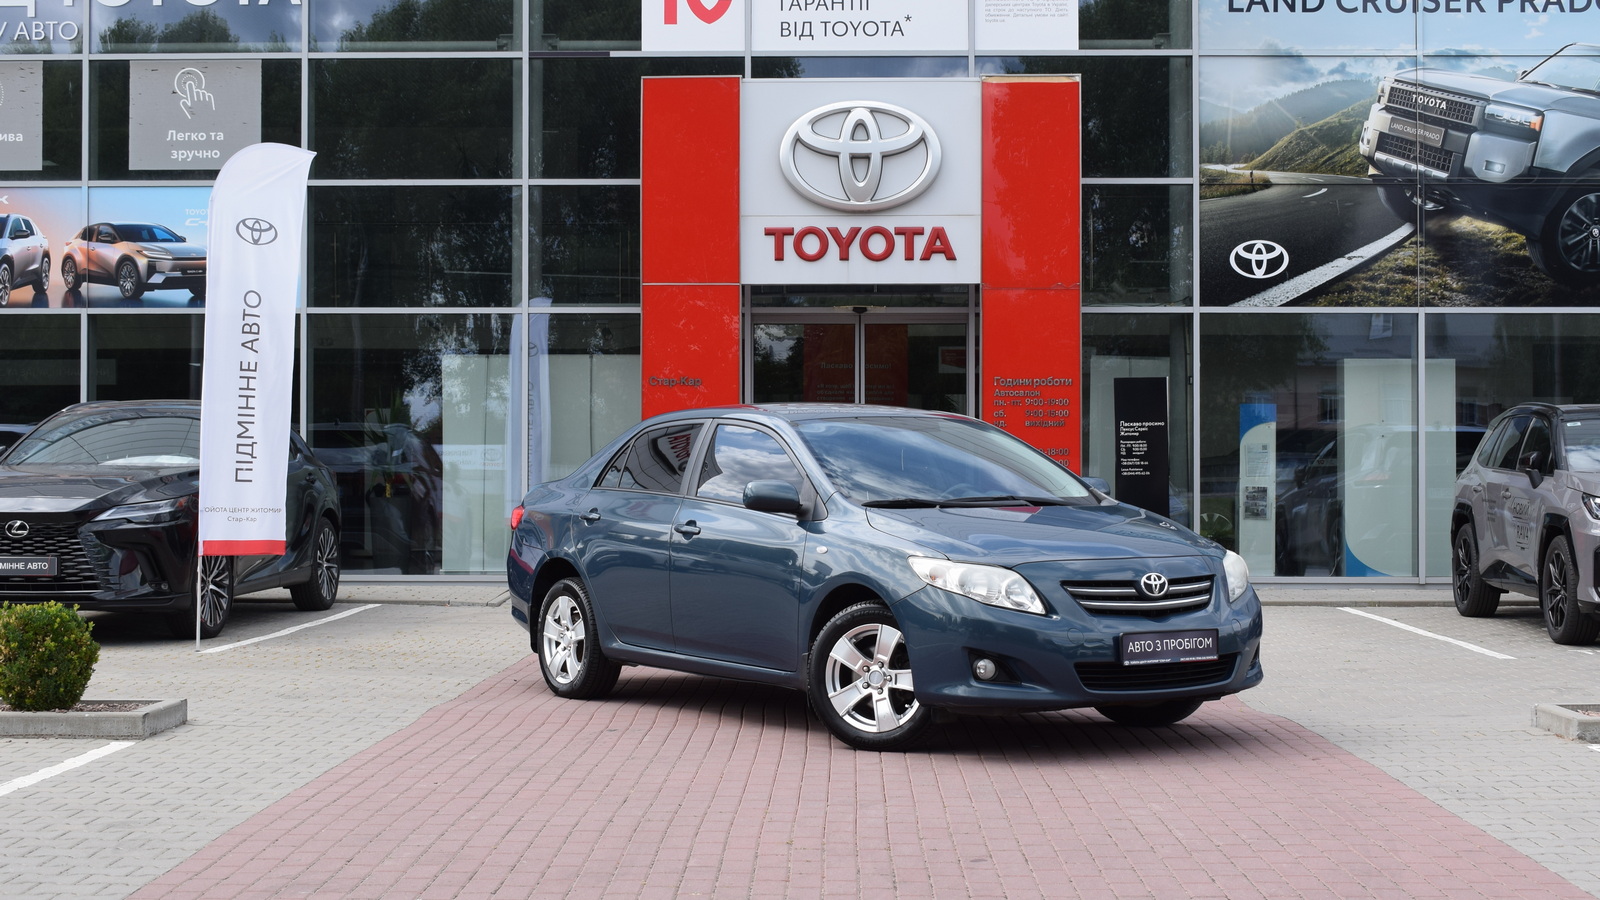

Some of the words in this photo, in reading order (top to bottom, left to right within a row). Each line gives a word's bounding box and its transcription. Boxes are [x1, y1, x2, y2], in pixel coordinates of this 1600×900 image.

[14, 21, 78, 40] АВТО
[780, 22, 814, 40] ВІД
[1412, 94, 1446, 110] TOYOTA
[166, 130, 206, 142] Легко
[210, 132, 224, 141] та
[1390, 122, 1403, 130] LAND
[1424, 131, 1440, 140] PRADO
[170, 150, 220, 160] зручно
[764, 226, 957, 262] TOYOTA
[241, 290, 262, 354] АВТО
[649, 376, 702, 388] Стар-Кар
[994, 376, 1032, 387] Години
[1034, 376, 1072, 388] роботи
[235, 361, 258, 483] ПІДМІННЕ
[1025, 419, 1065, 427] вихідний
[1516, 525, 1529, 540] RAV4
[1128, 640, 1153, 653] АВТО
[1156, 640, 1161, 651] З
[1163, 638, 1212, 650] ПРОБІГОМ
